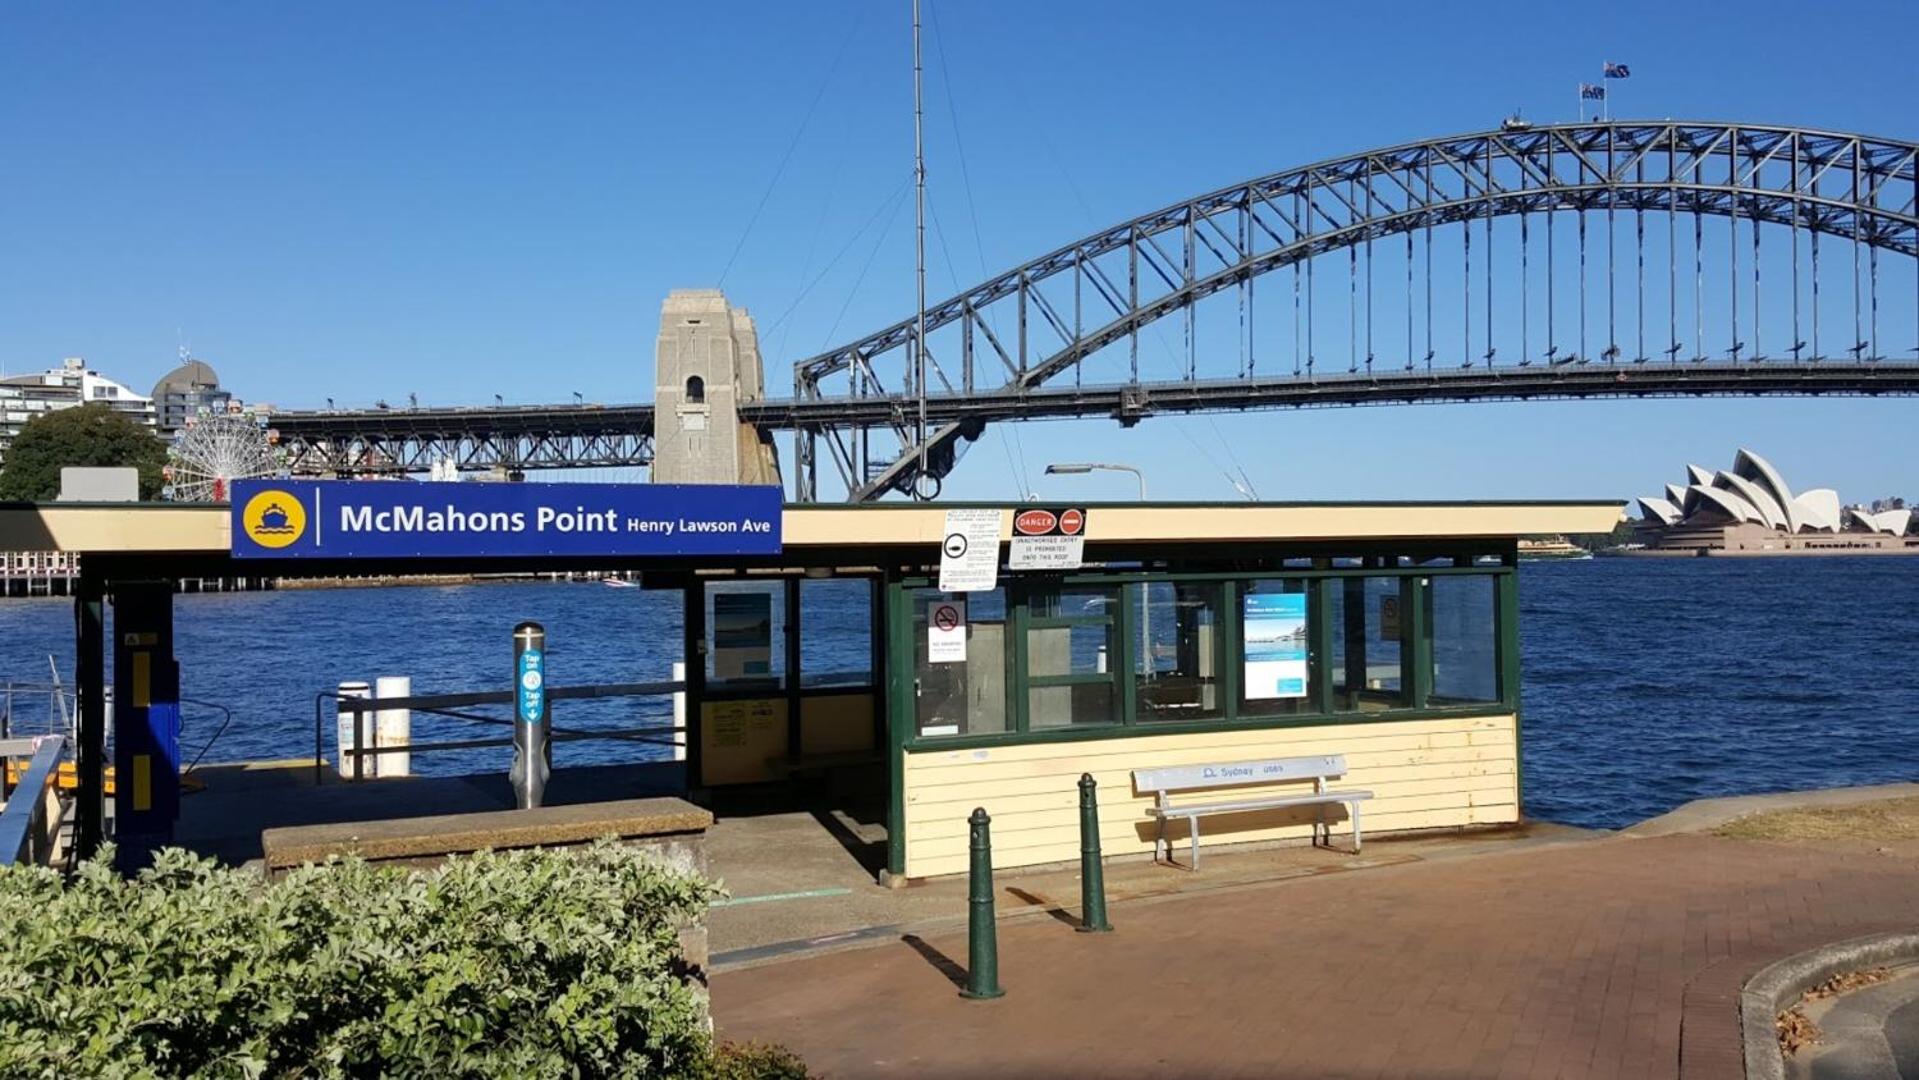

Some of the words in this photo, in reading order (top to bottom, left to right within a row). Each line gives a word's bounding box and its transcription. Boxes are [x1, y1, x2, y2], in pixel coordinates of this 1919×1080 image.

[340, 505, 525, 532] McMahons
[537, 506, 618, 532] Point
[627, 518, 675, 536] Henry
[679, 518, 737, 532] Lawson
[741, 518, 771, 532] Ave
[1020, 518, 1053, 527] DANGER
[525, 654, 540, 663] Tap
[525, 691, 540, 700] Tap
[1220, 767, 1253, 777] Sydney
